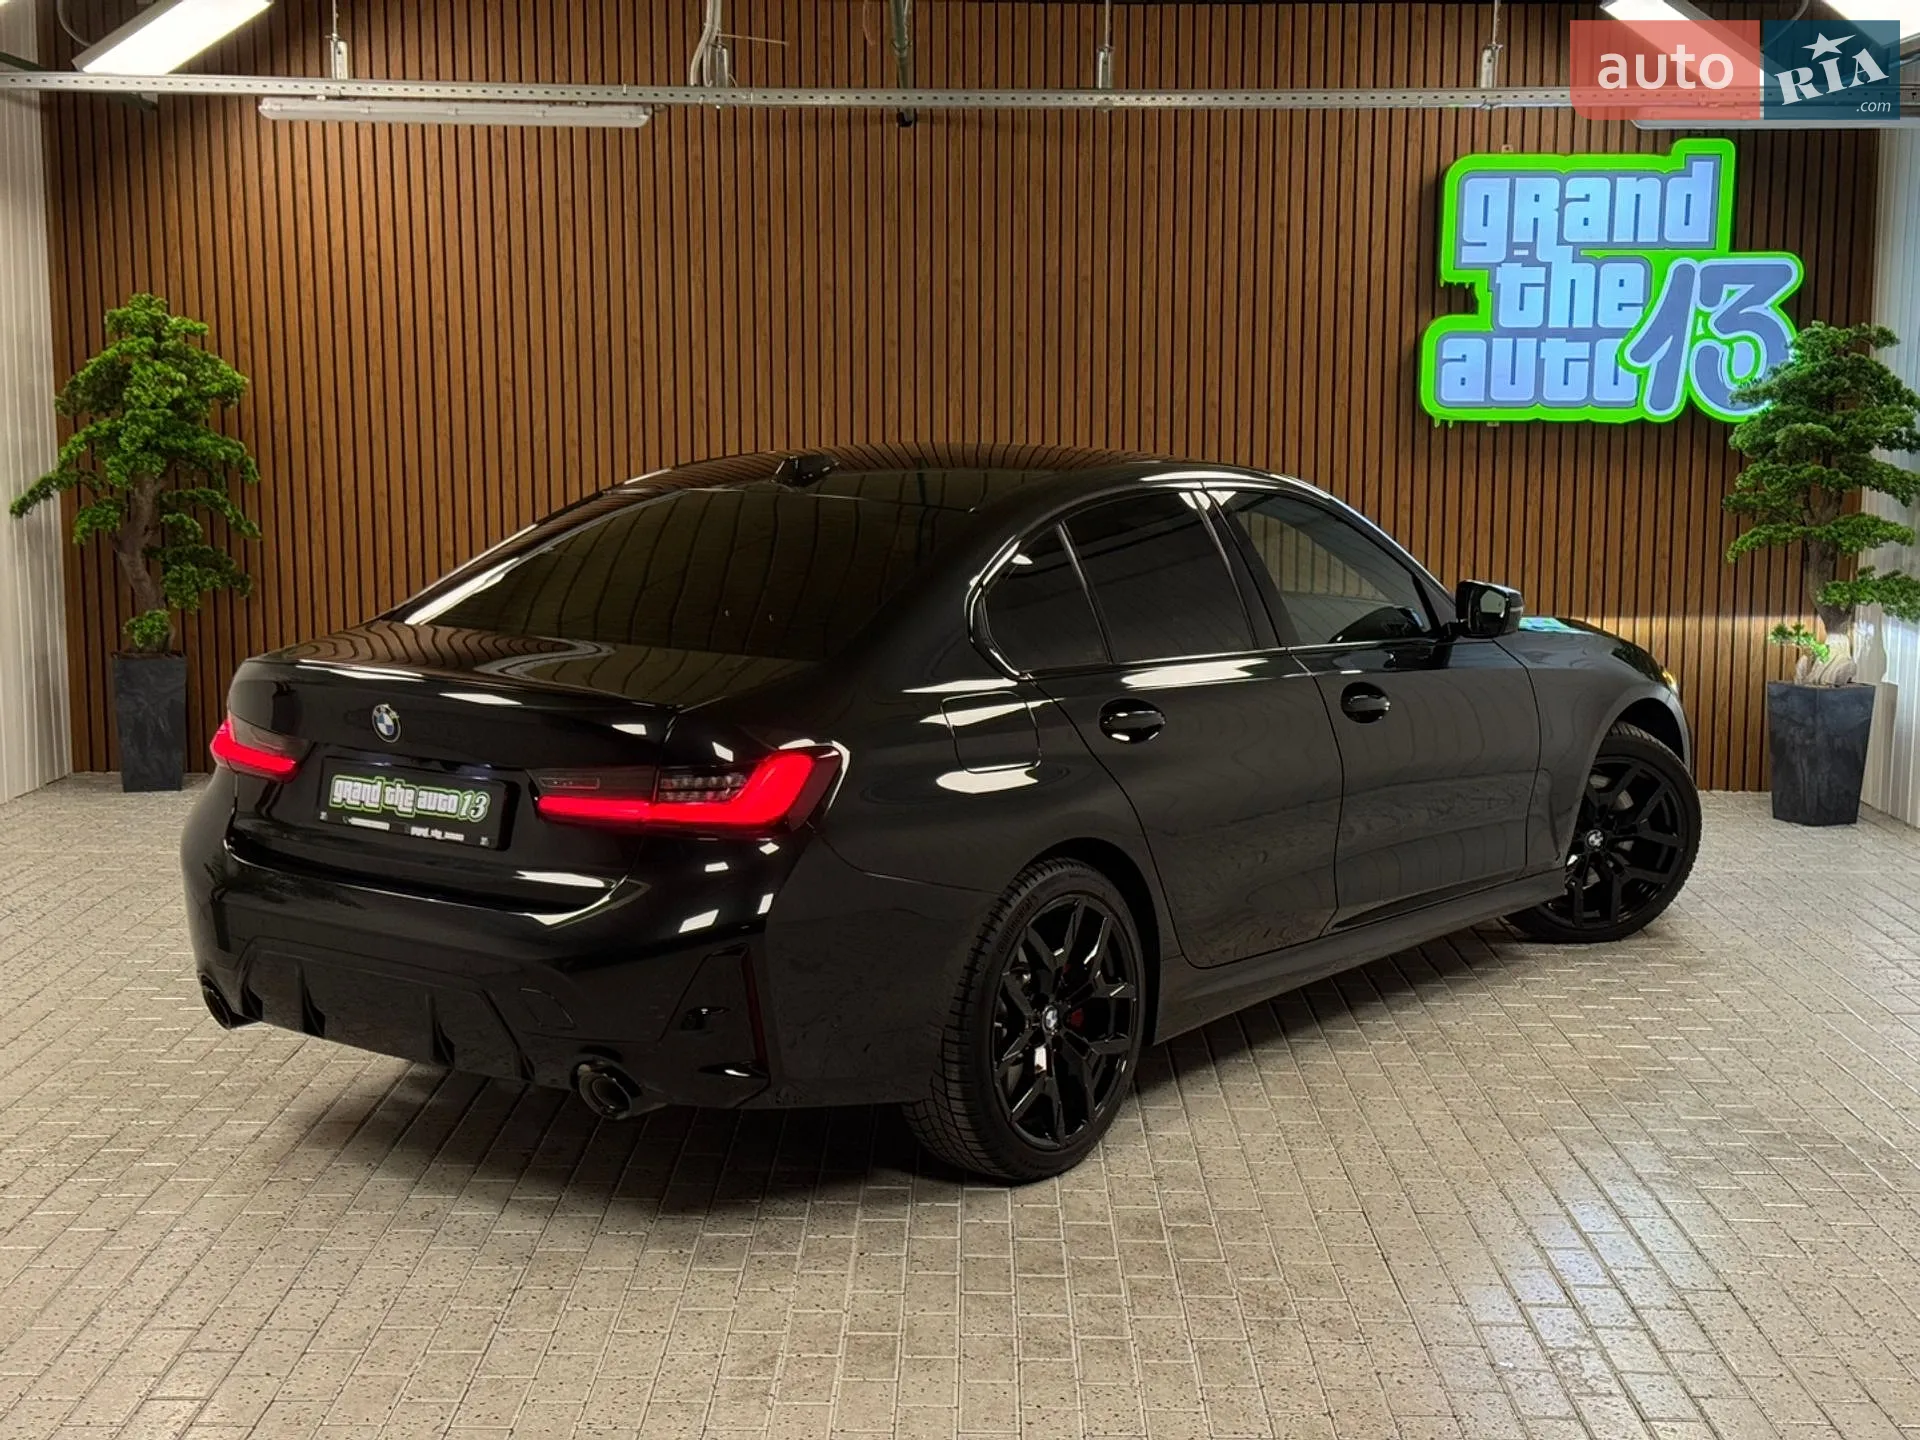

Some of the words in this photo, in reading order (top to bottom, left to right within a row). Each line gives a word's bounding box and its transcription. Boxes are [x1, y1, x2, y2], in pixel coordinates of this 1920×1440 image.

[1496, 245, 1646, 328] the
[1627, 258, 1796, 416] 13
[333, 779, 382, 808] grand
[385, 783, 415, 813] the
[418, 790, 459, 814] auto
[460, 794, 487, 819] 13
